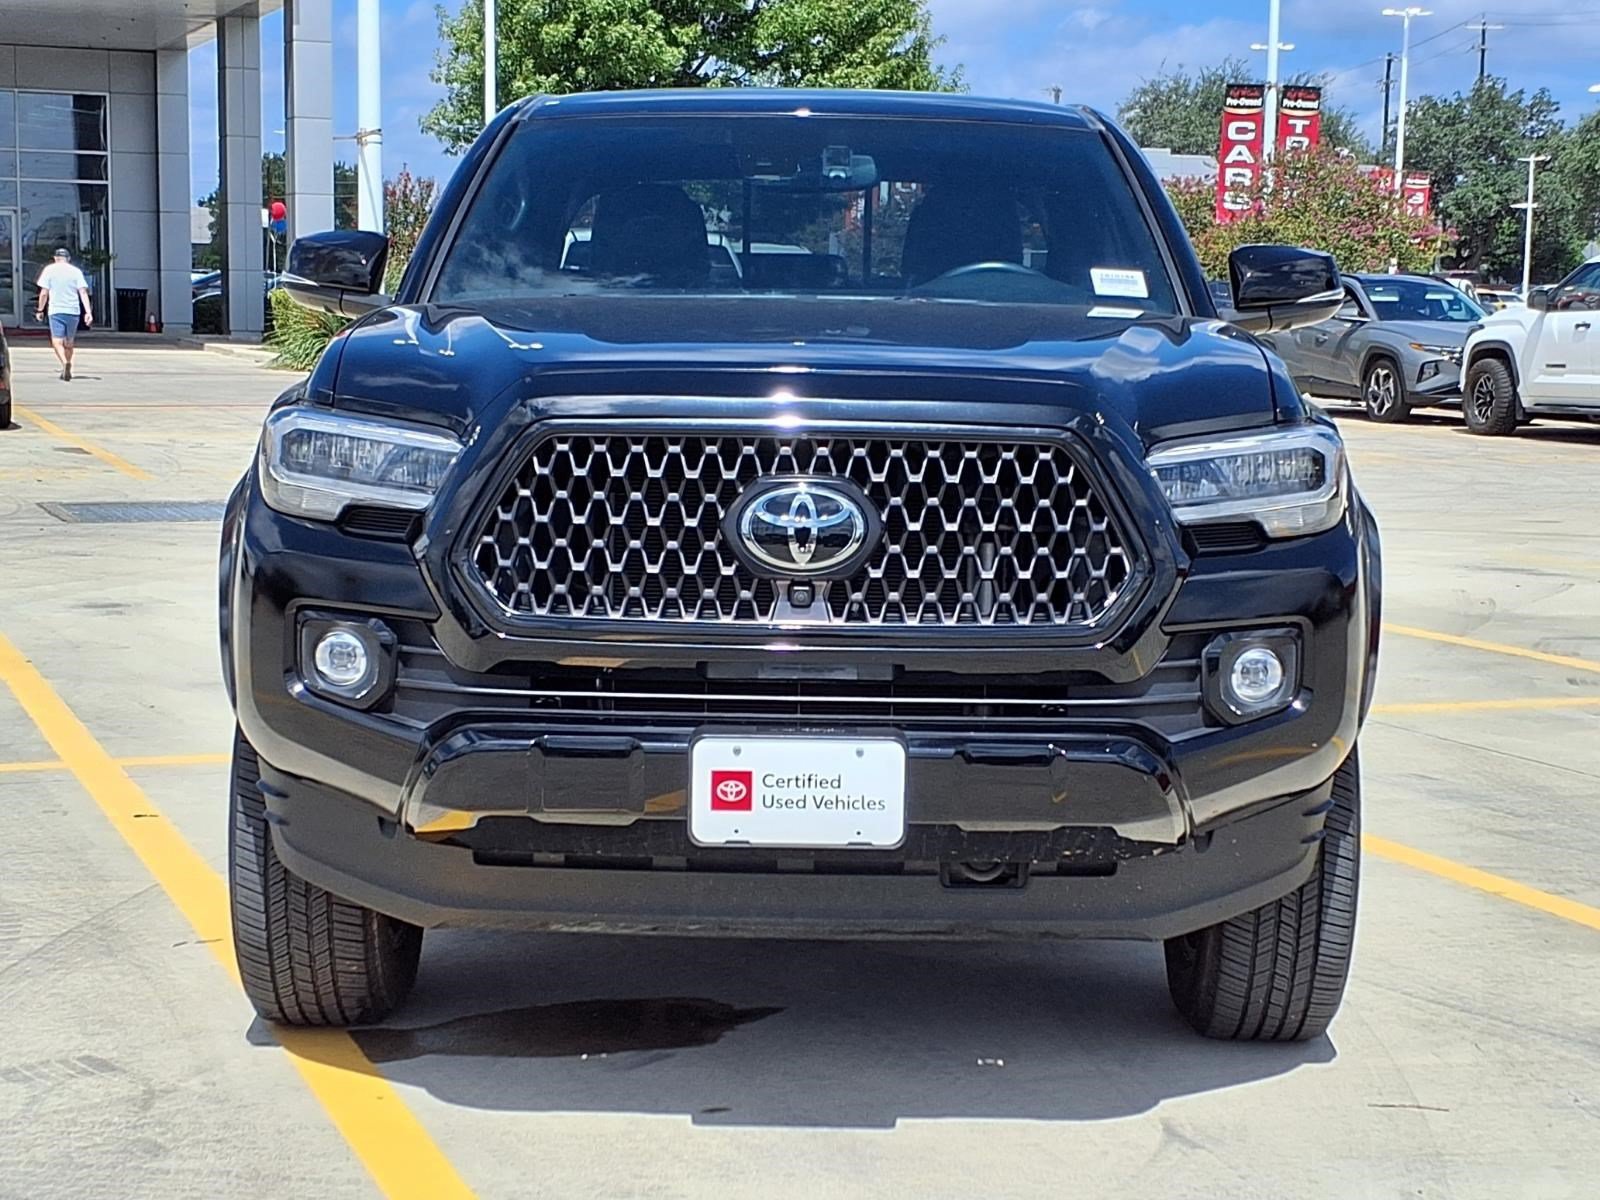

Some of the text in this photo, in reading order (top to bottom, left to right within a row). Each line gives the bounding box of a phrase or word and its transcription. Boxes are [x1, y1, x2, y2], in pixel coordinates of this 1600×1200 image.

[1223, 121, 1256, 210] CARS
[762, 773, 842, 789] Certified
[762, 795, 886, 811] Used Vehicles
